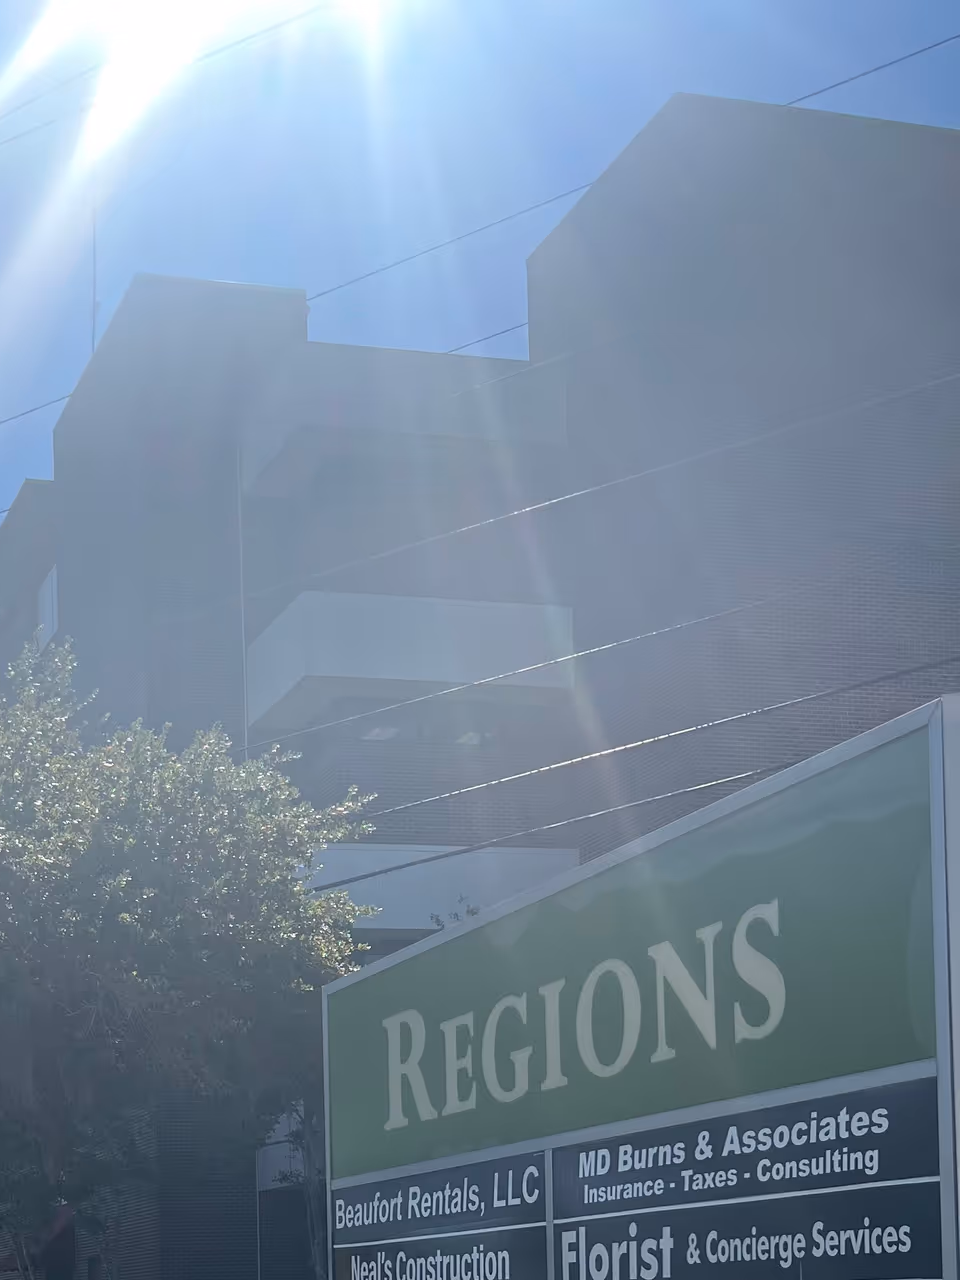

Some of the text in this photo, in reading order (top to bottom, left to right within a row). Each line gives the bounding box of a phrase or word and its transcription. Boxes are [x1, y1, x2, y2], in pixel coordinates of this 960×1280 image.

[382, 898, 787, 1131] REGIONS
[578, 1106, 889, 1178] MD Burns & Associates
[335, 1165, 539, 1229] Beaufort Rentals, LLC
[583, 1179, 664, 1204] Insurance
[680, 1168, 737, 1191] Taxes
[756, 1147, 879, 1181] Consulting
[686, 1233, 701, 1265] &
[705, 1226, 805, 1268] Concierge
[811, 1217, 912, 1257] Services
